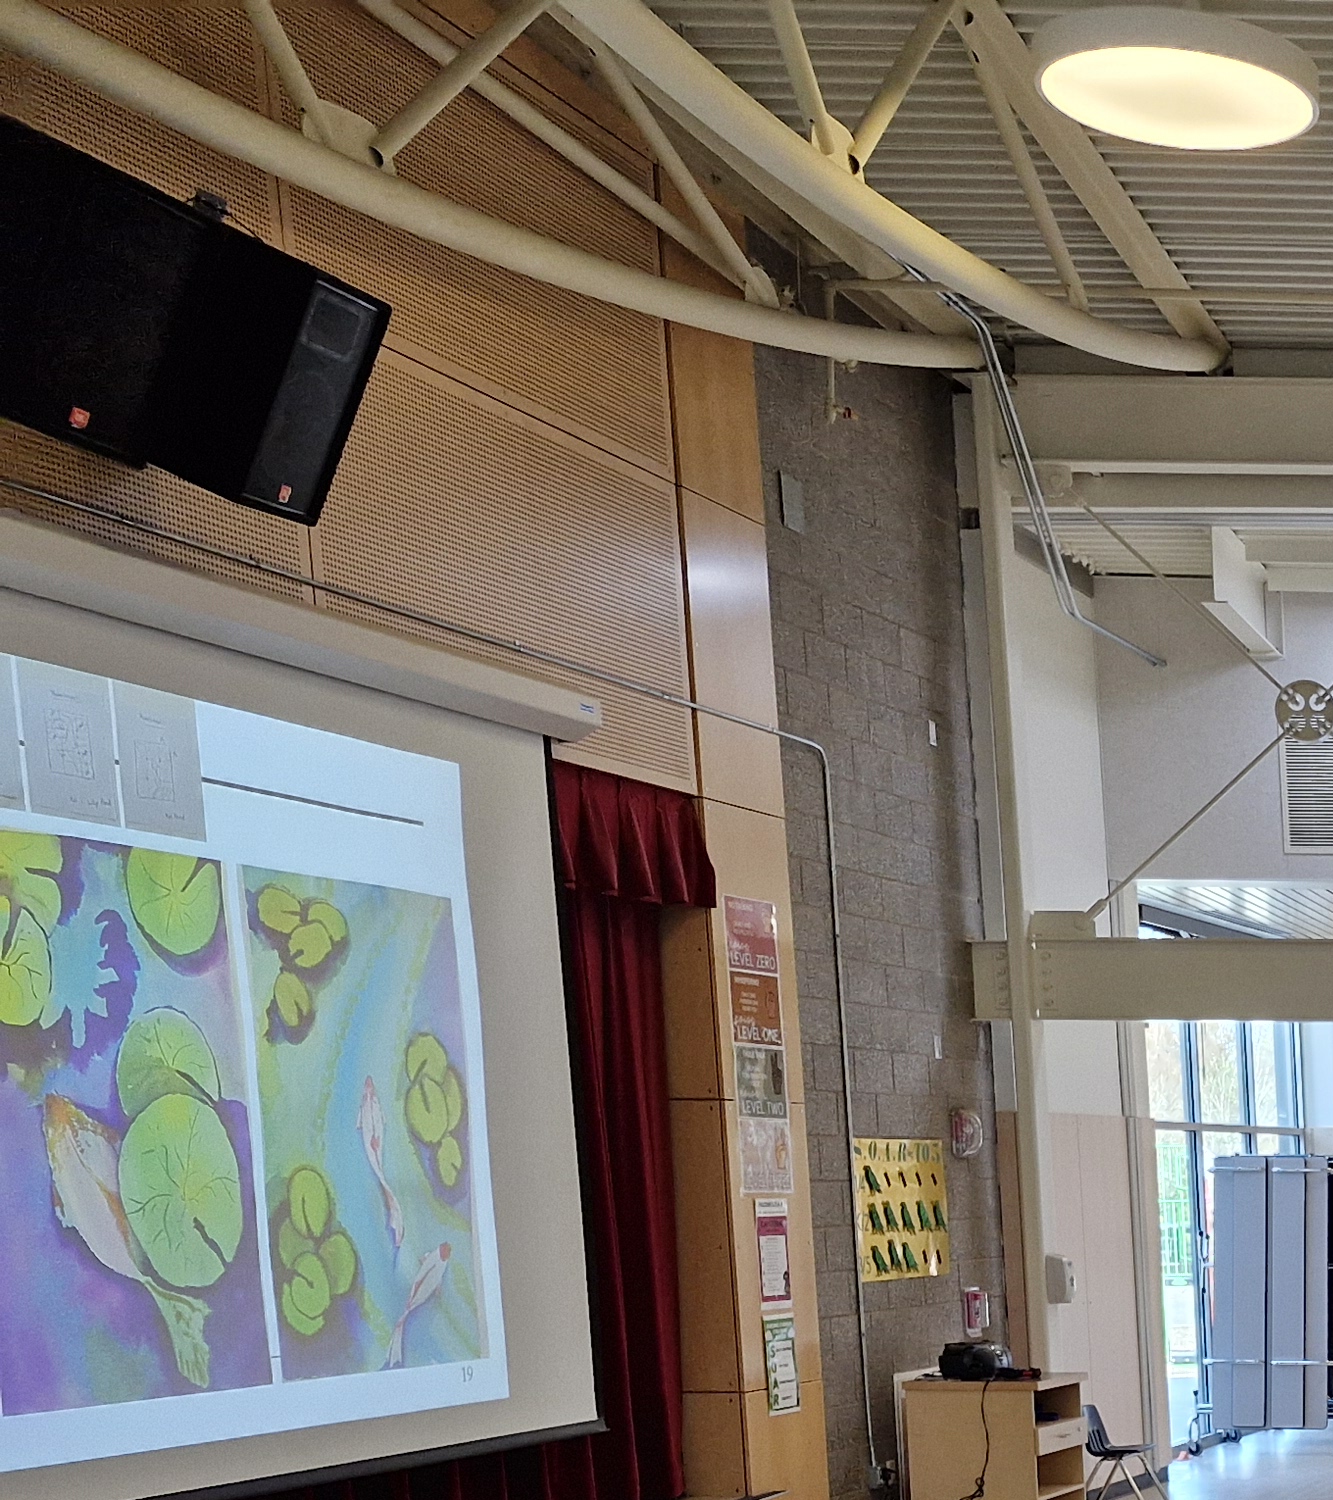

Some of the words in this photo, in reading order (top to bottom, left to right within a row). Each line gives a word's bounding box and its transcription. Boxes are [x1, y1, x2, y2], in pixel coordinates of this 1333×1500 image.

[729, 951, 755, 967] LEVEL
[756, 954, 776, 970] ZERO
[737, 1024, 762, 1041] LEVEL
[762, 1028, 779, 1042] ONE
[742, 1100, 765, 1115] LEVEL
[767, 1102, 785, 1116] TWO
[462, 1365, 474, 1382] 19
